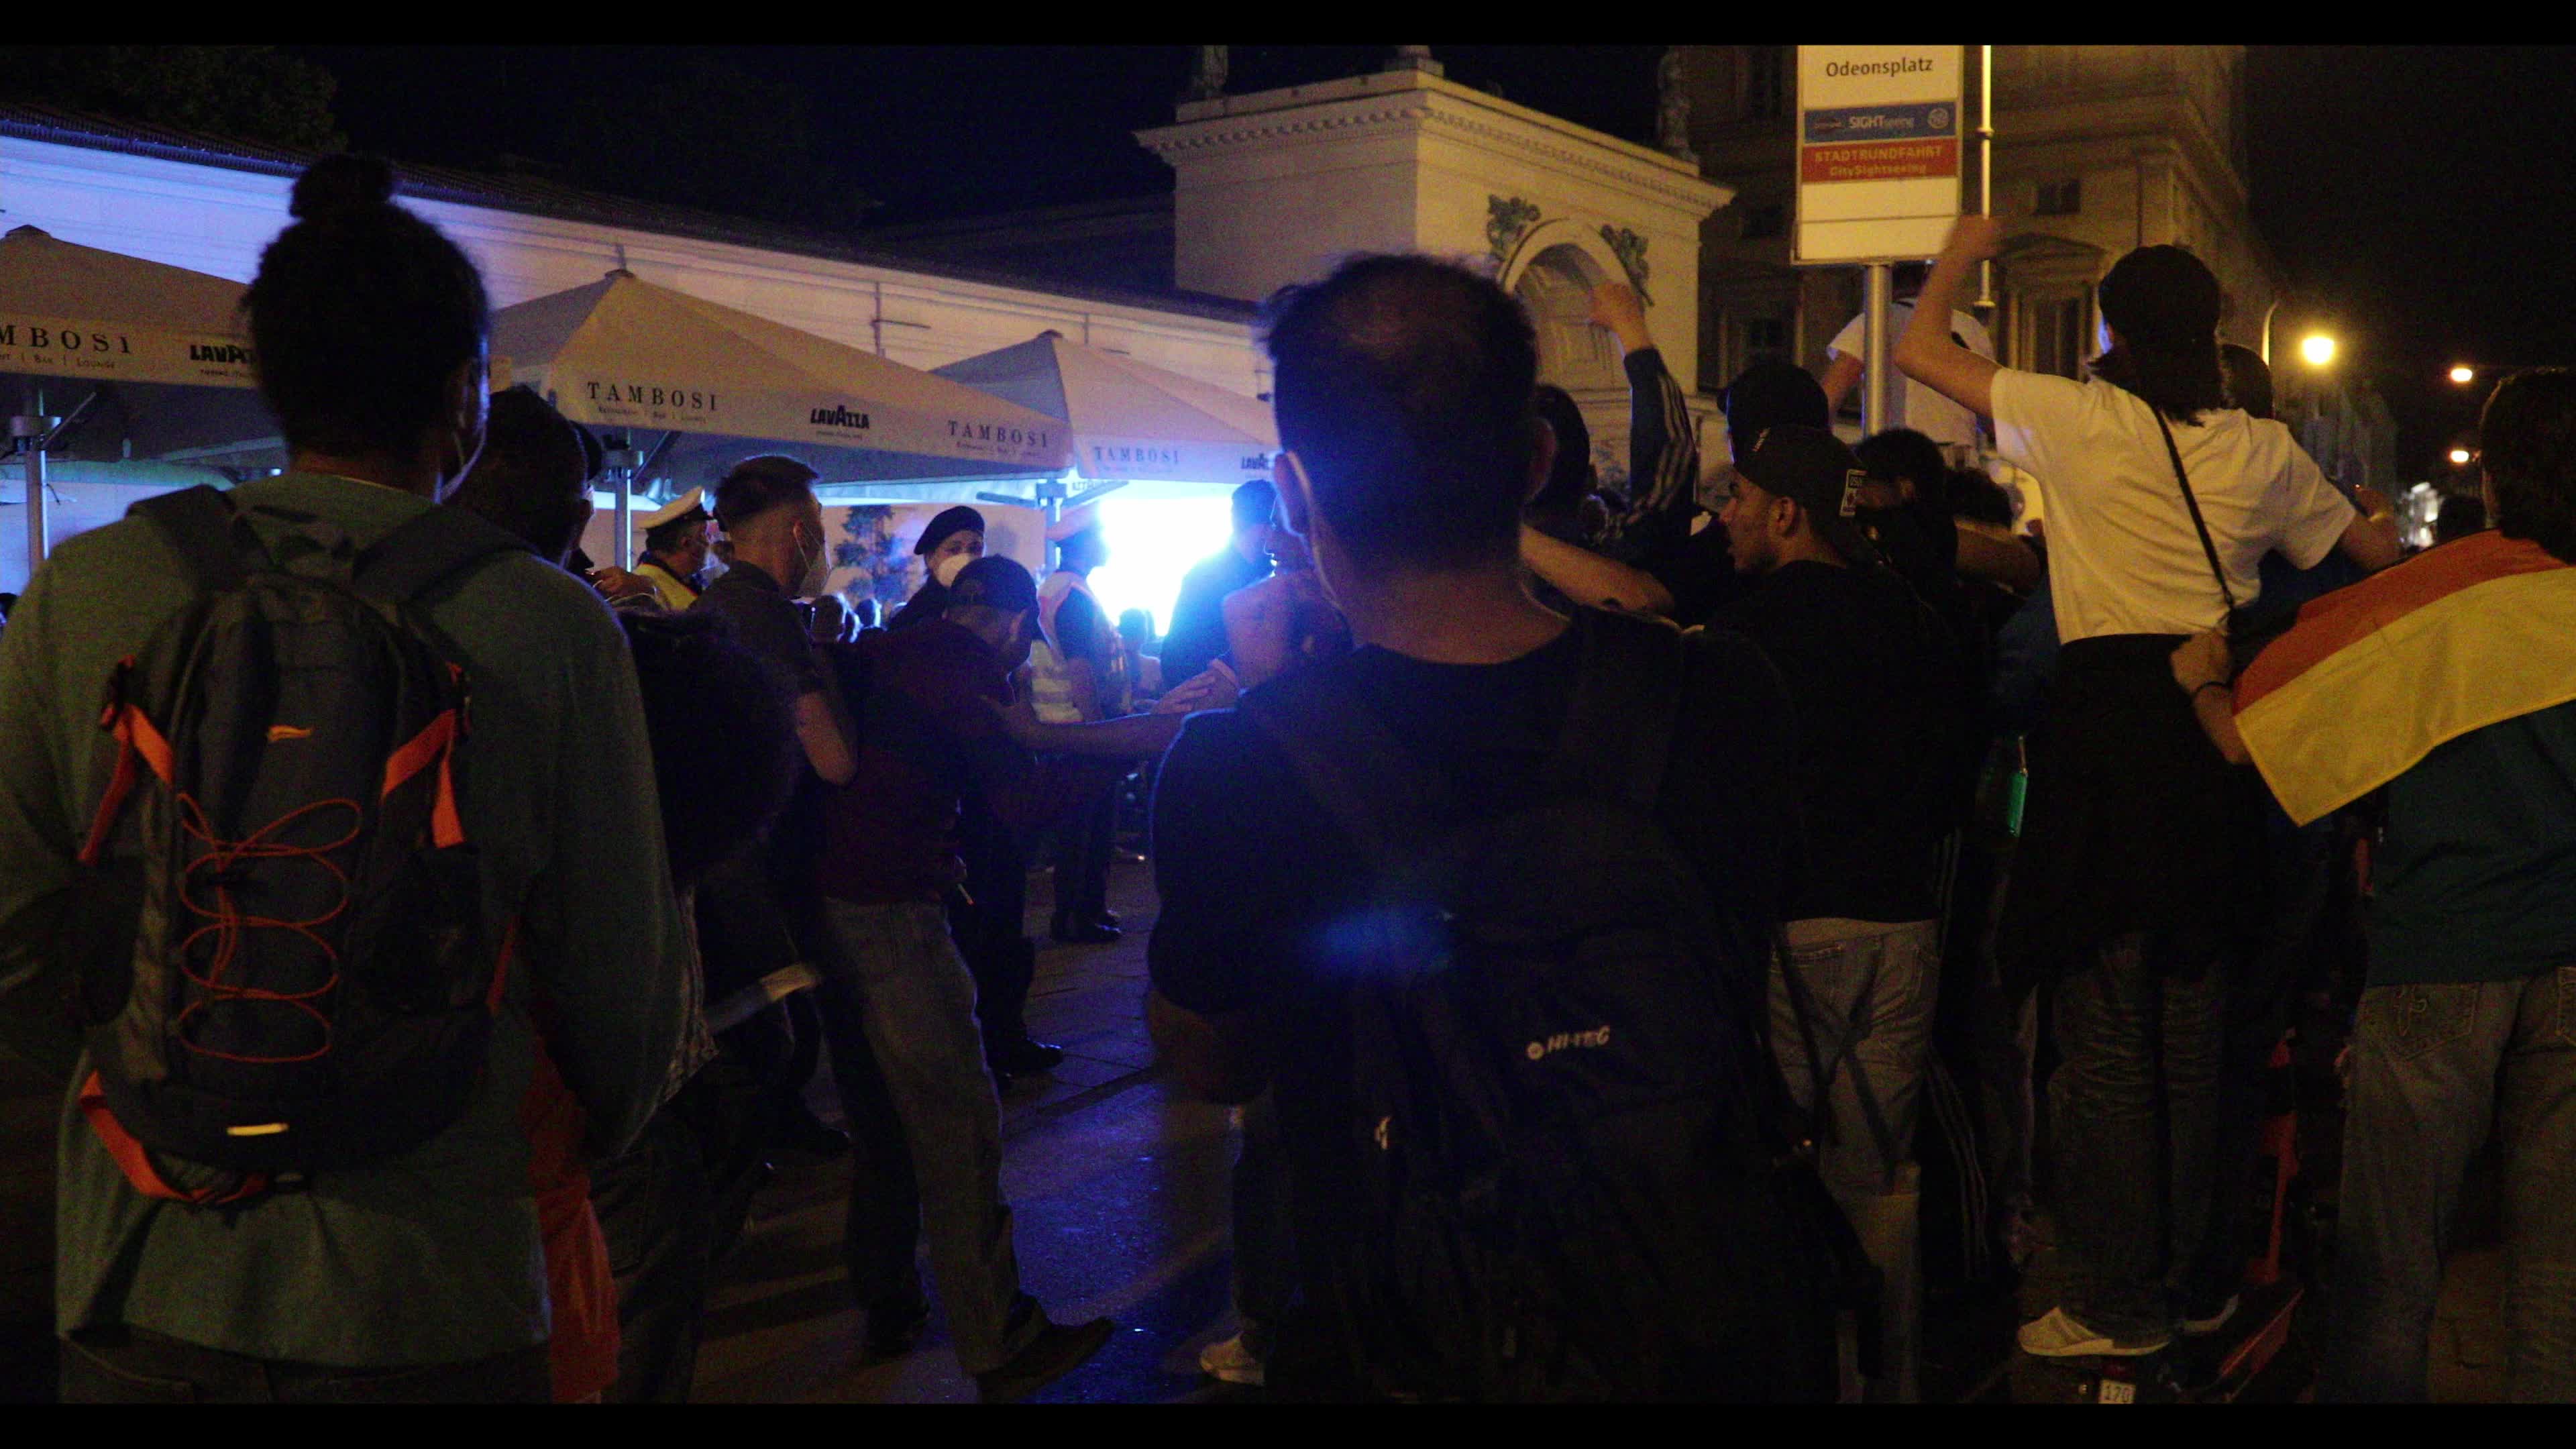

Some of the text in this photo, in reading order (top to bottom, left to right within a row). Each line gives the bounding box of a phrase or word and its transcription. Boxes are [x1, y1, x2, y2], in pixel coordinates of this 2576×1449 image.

[1825, 56, 1933, 77] Odeonsplatz
[1815, 145, 1943, 162] STADTRUNDFAHRT
[588, 381, 716, 411] TAMBOSI
[810, 405, 870, 429] LAVAZZA
[948, 420, 1048, 447] TAMBOSI
[1093, 445, 1180, 464] TAMBOSI
[1546, 1024, 1611, 1053] HI-TEC
